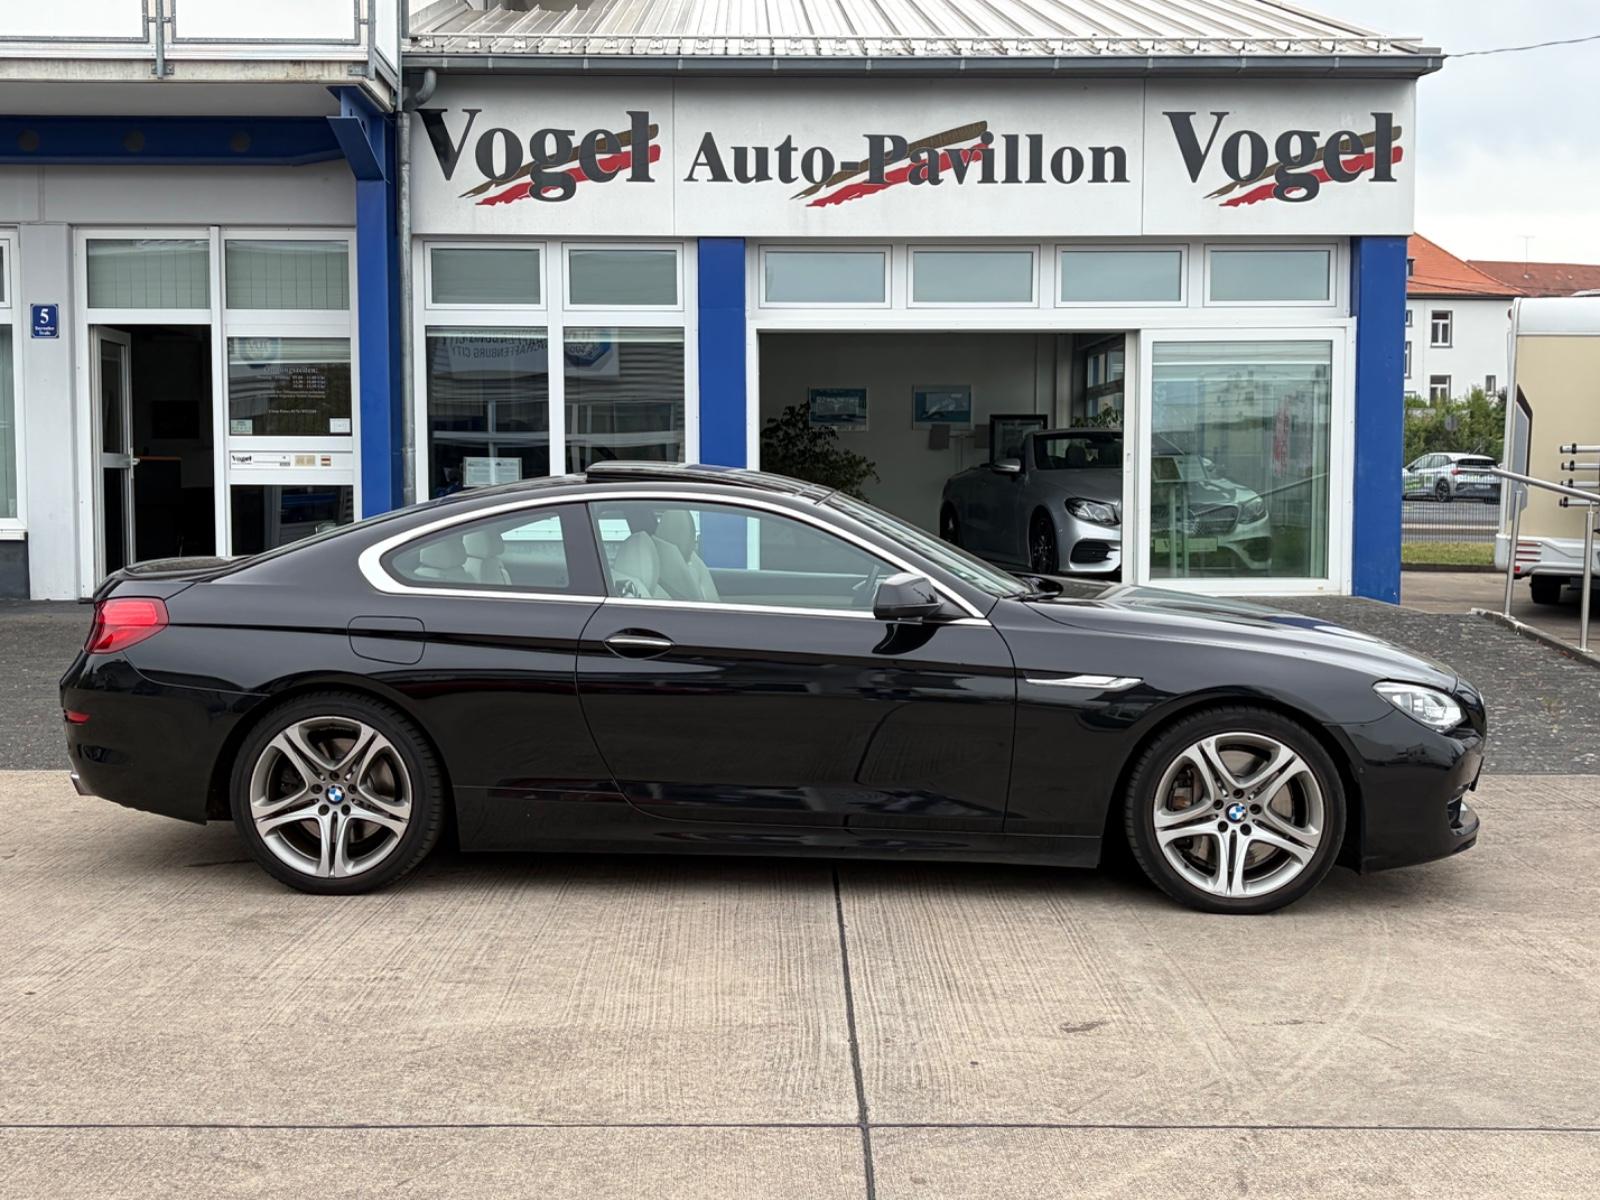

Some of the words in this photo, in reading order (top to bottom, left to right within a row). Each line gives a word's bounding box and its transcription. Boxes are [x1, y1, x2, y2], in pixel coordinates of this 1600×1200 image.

[415, 108, 656, 202] Vogel
[683, 130, 1131, 186] Auto-Pavillon
[1162, 111, 1398, 203] Vogel
[40, 308, 49, 324] 5
